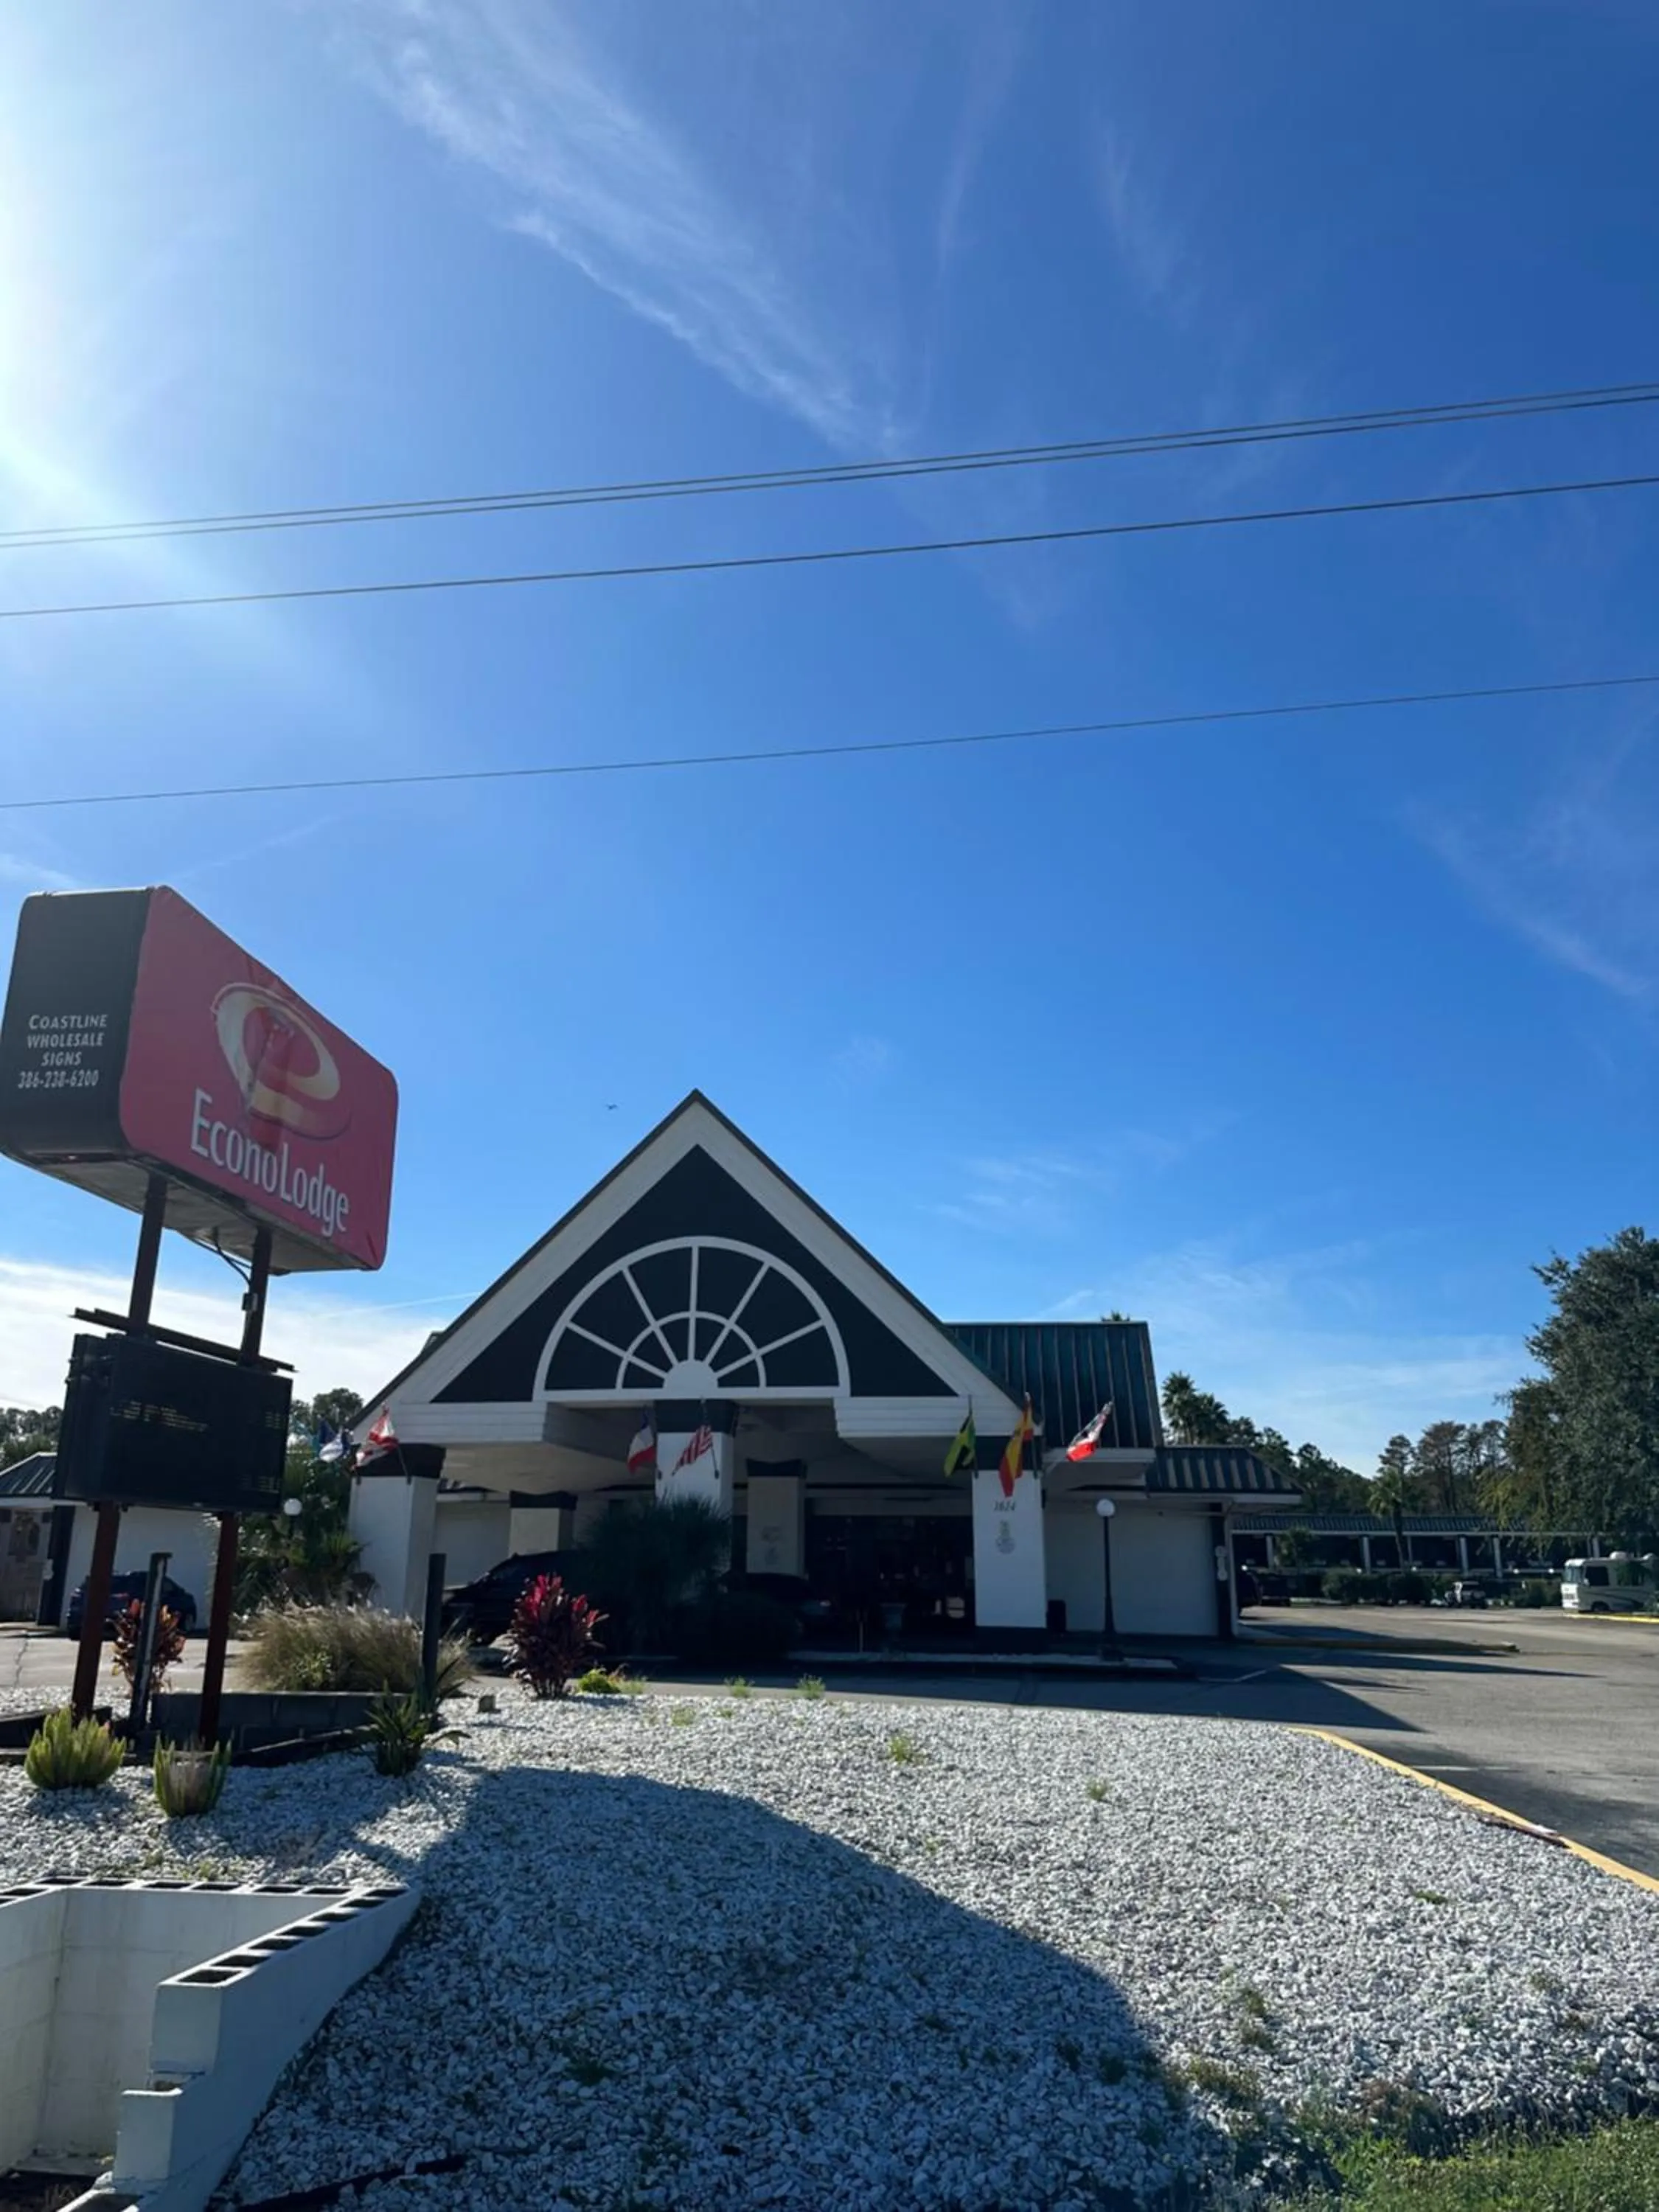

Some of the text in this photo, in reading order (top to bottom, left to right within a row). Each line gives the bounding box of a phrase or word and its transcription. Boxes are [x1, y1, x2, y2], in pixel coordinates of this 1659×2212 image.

[28, 1014, 108, 1030] COASTLINE
[27, 1032, 104, 1048] WHOLESALE
[41, 1051, 82, 1066] SIGNS
[18, 1069, 99, 1089] 386-238-6200
